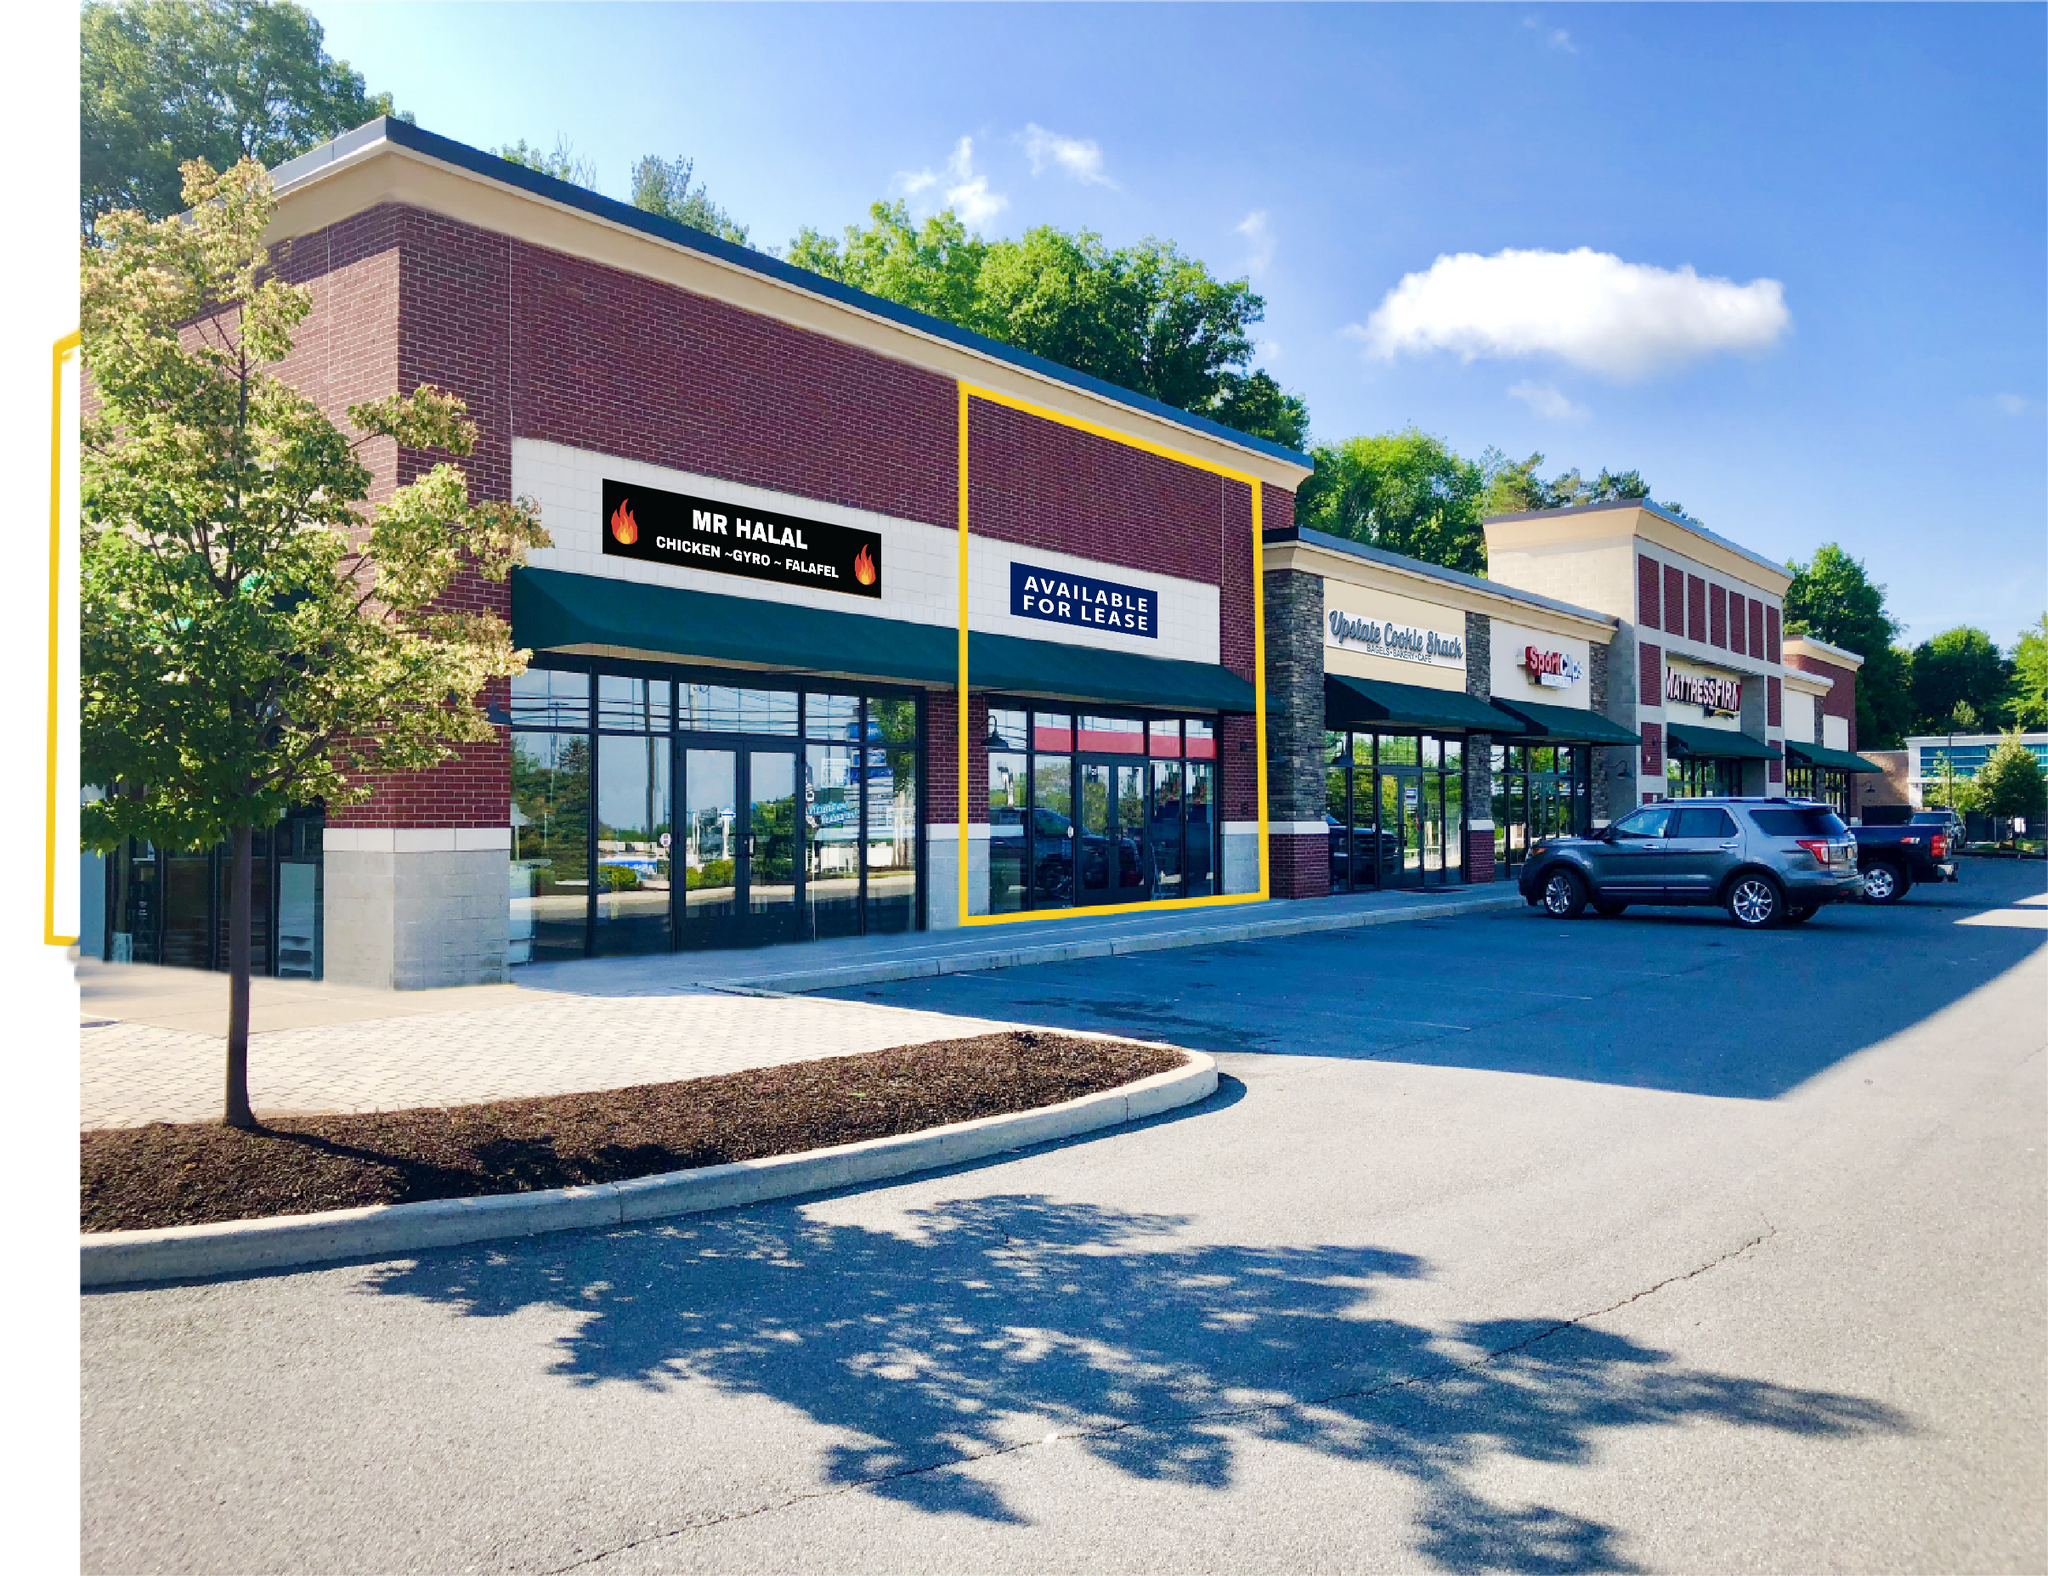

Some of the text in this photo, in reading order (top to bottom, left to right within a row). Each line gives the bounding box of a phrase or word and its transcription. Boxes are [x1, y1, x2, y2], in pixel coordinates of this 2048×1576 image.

[692, 509, 808, 550] MR HALAL
[656, 536, 721, 558] CHICKEN
[785, 558, 839, 579] FALAFEL
[1023, 594, 1148, 631] FOR LEASE
[1024, 575, 1148, 613] AVAILABLE
[1328, 610, 1464, 659] Upstate Cookie Shack
[1366, 643, 1432, 663] BAGELS BAKERY CAFE
